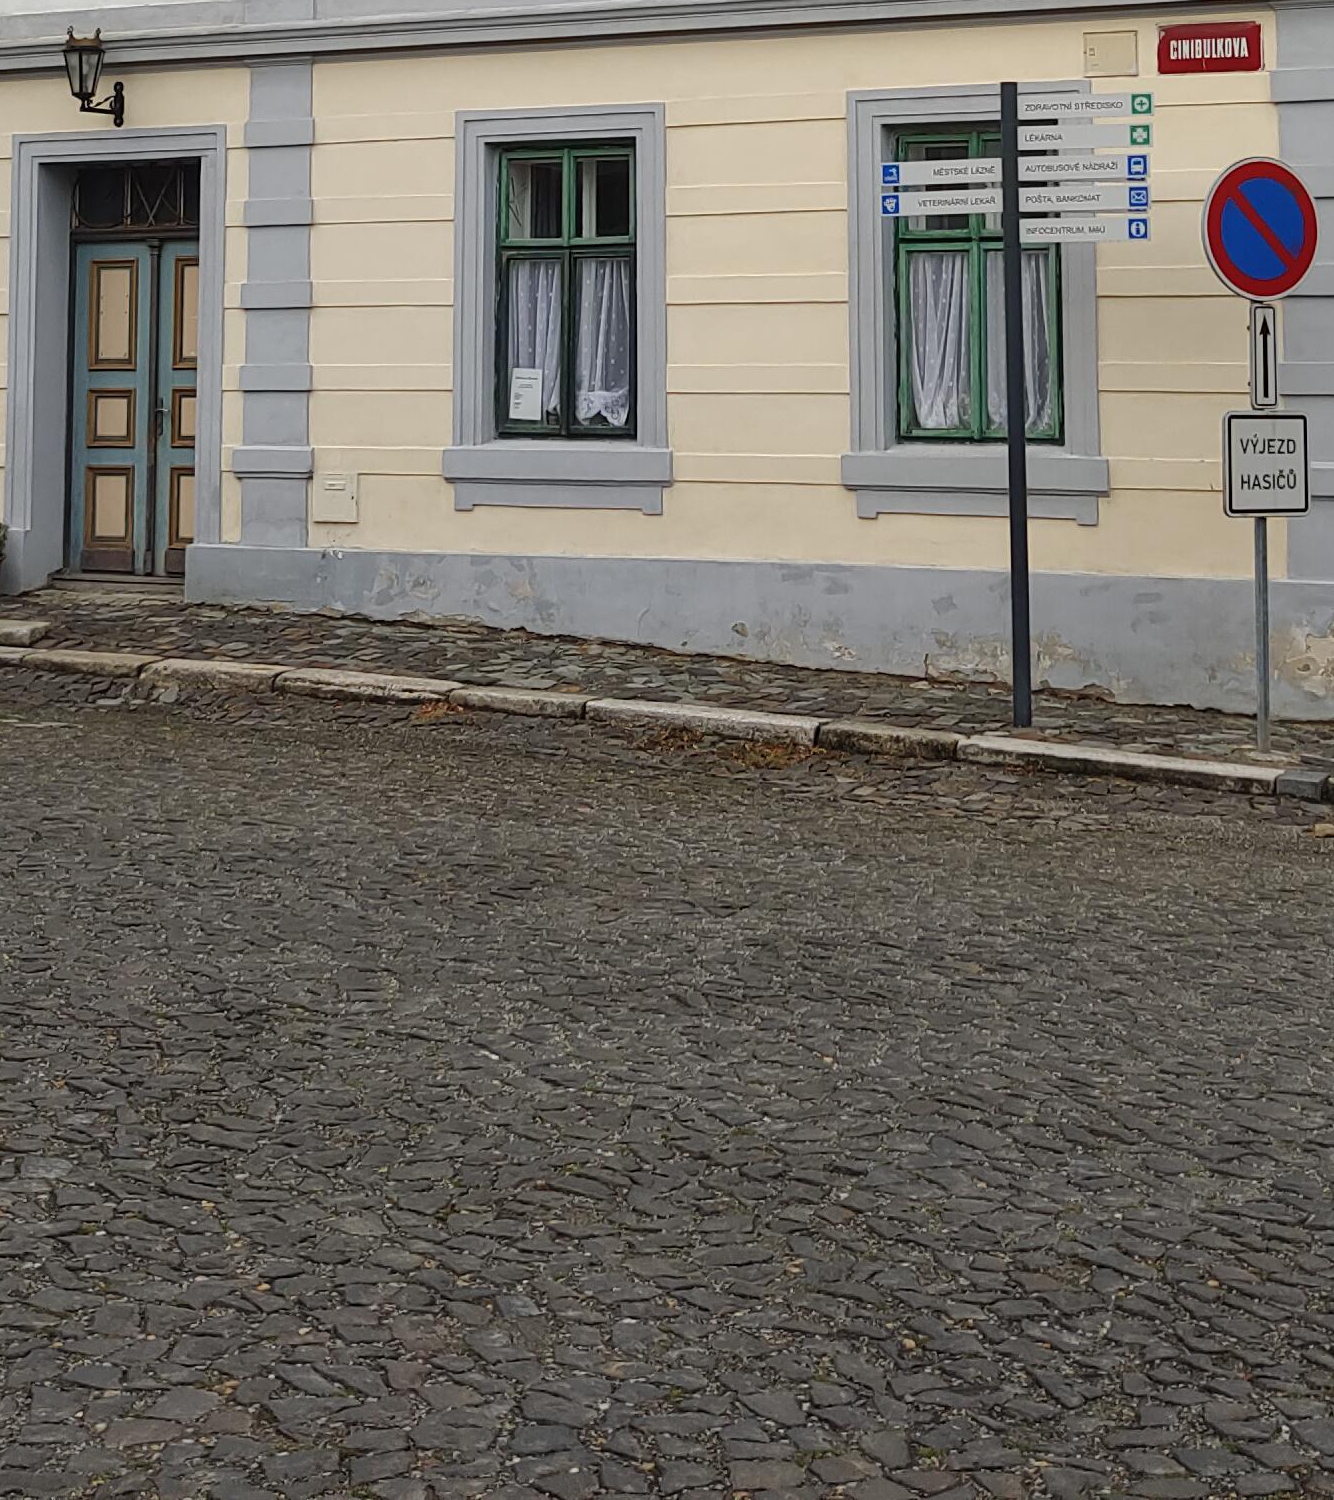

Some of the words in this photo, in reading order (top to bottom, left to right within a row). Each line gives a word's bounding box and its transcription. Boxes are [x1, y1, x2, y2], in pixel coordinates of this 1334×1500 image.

[1169, 36, 1249, 61] CINIBULKOVA
[1240, 433, 1296, 455] VÝJEZD
[1240, 468, 1297, 490] HASIČŮ
